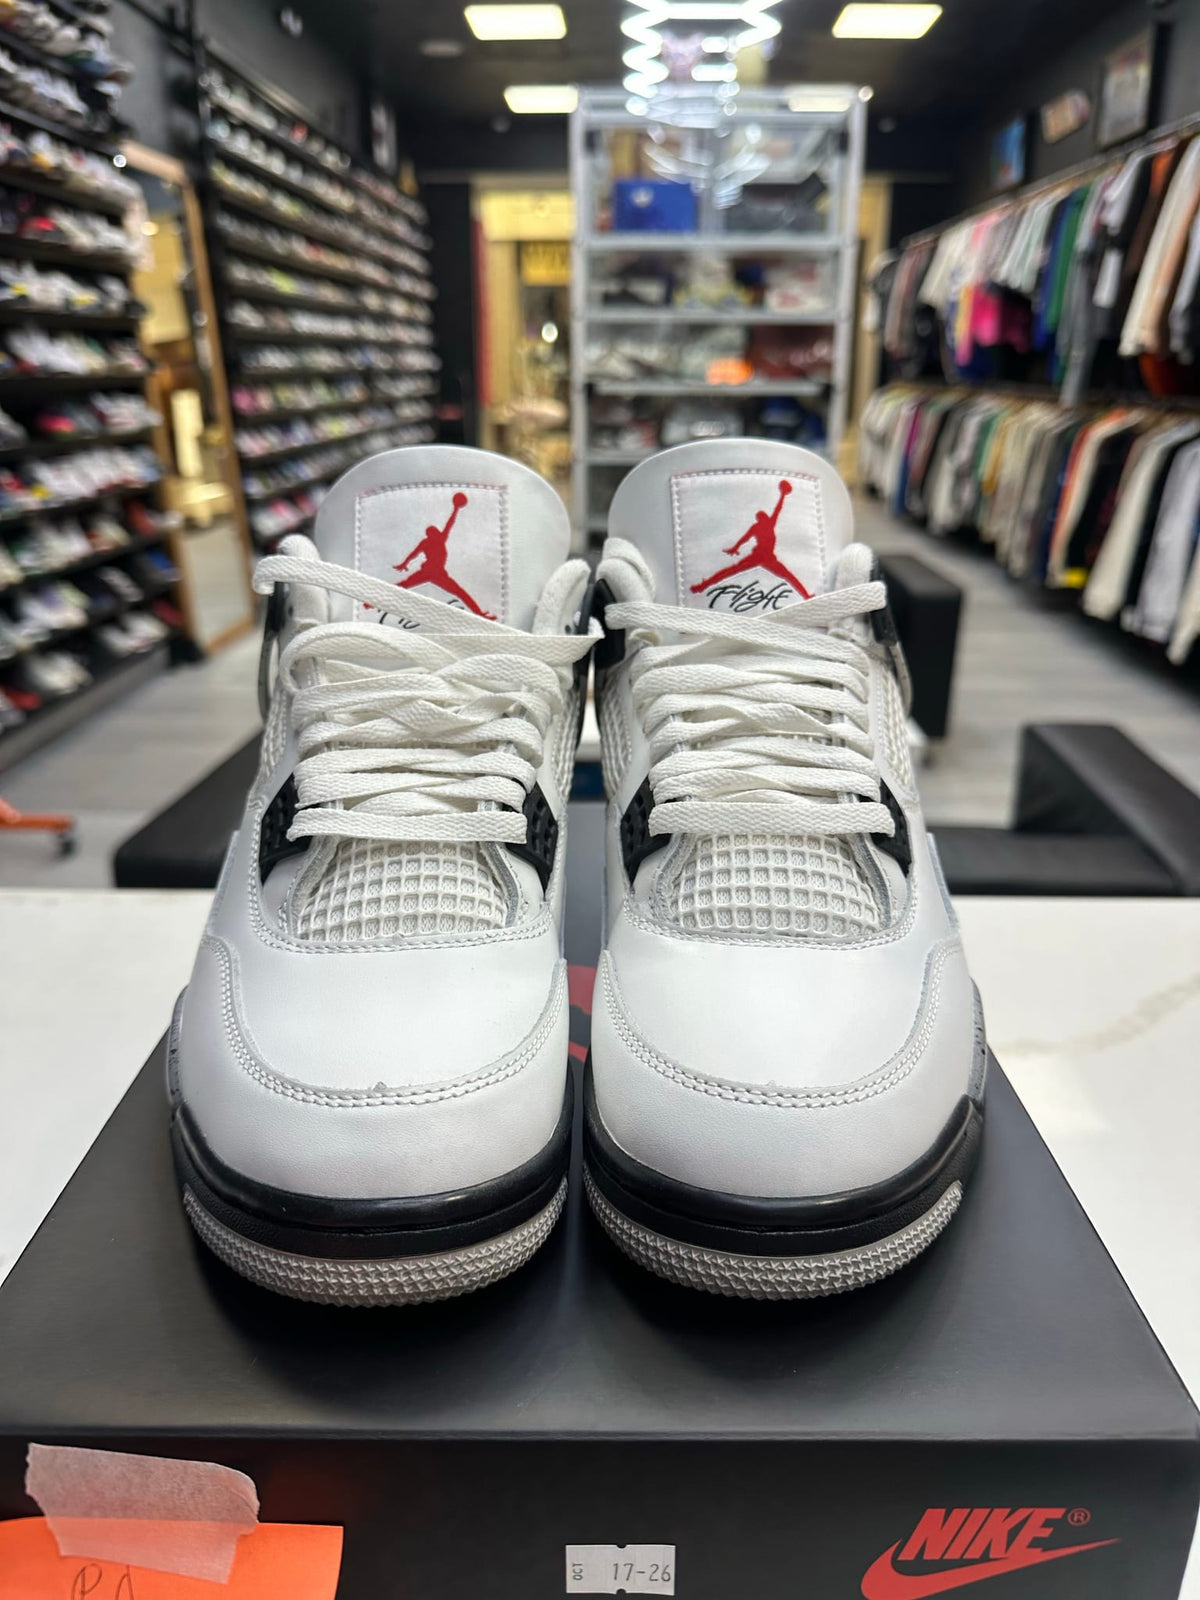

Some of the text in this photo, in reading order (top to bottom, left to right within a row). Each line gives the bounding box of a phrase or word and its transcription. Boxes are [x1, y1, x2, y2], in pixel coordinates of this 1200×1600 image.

[706, 580, 793, 612] Flight
[572, 1563, 584, 1581] OCT
[612, 1563, 672, 1582] 17-26
